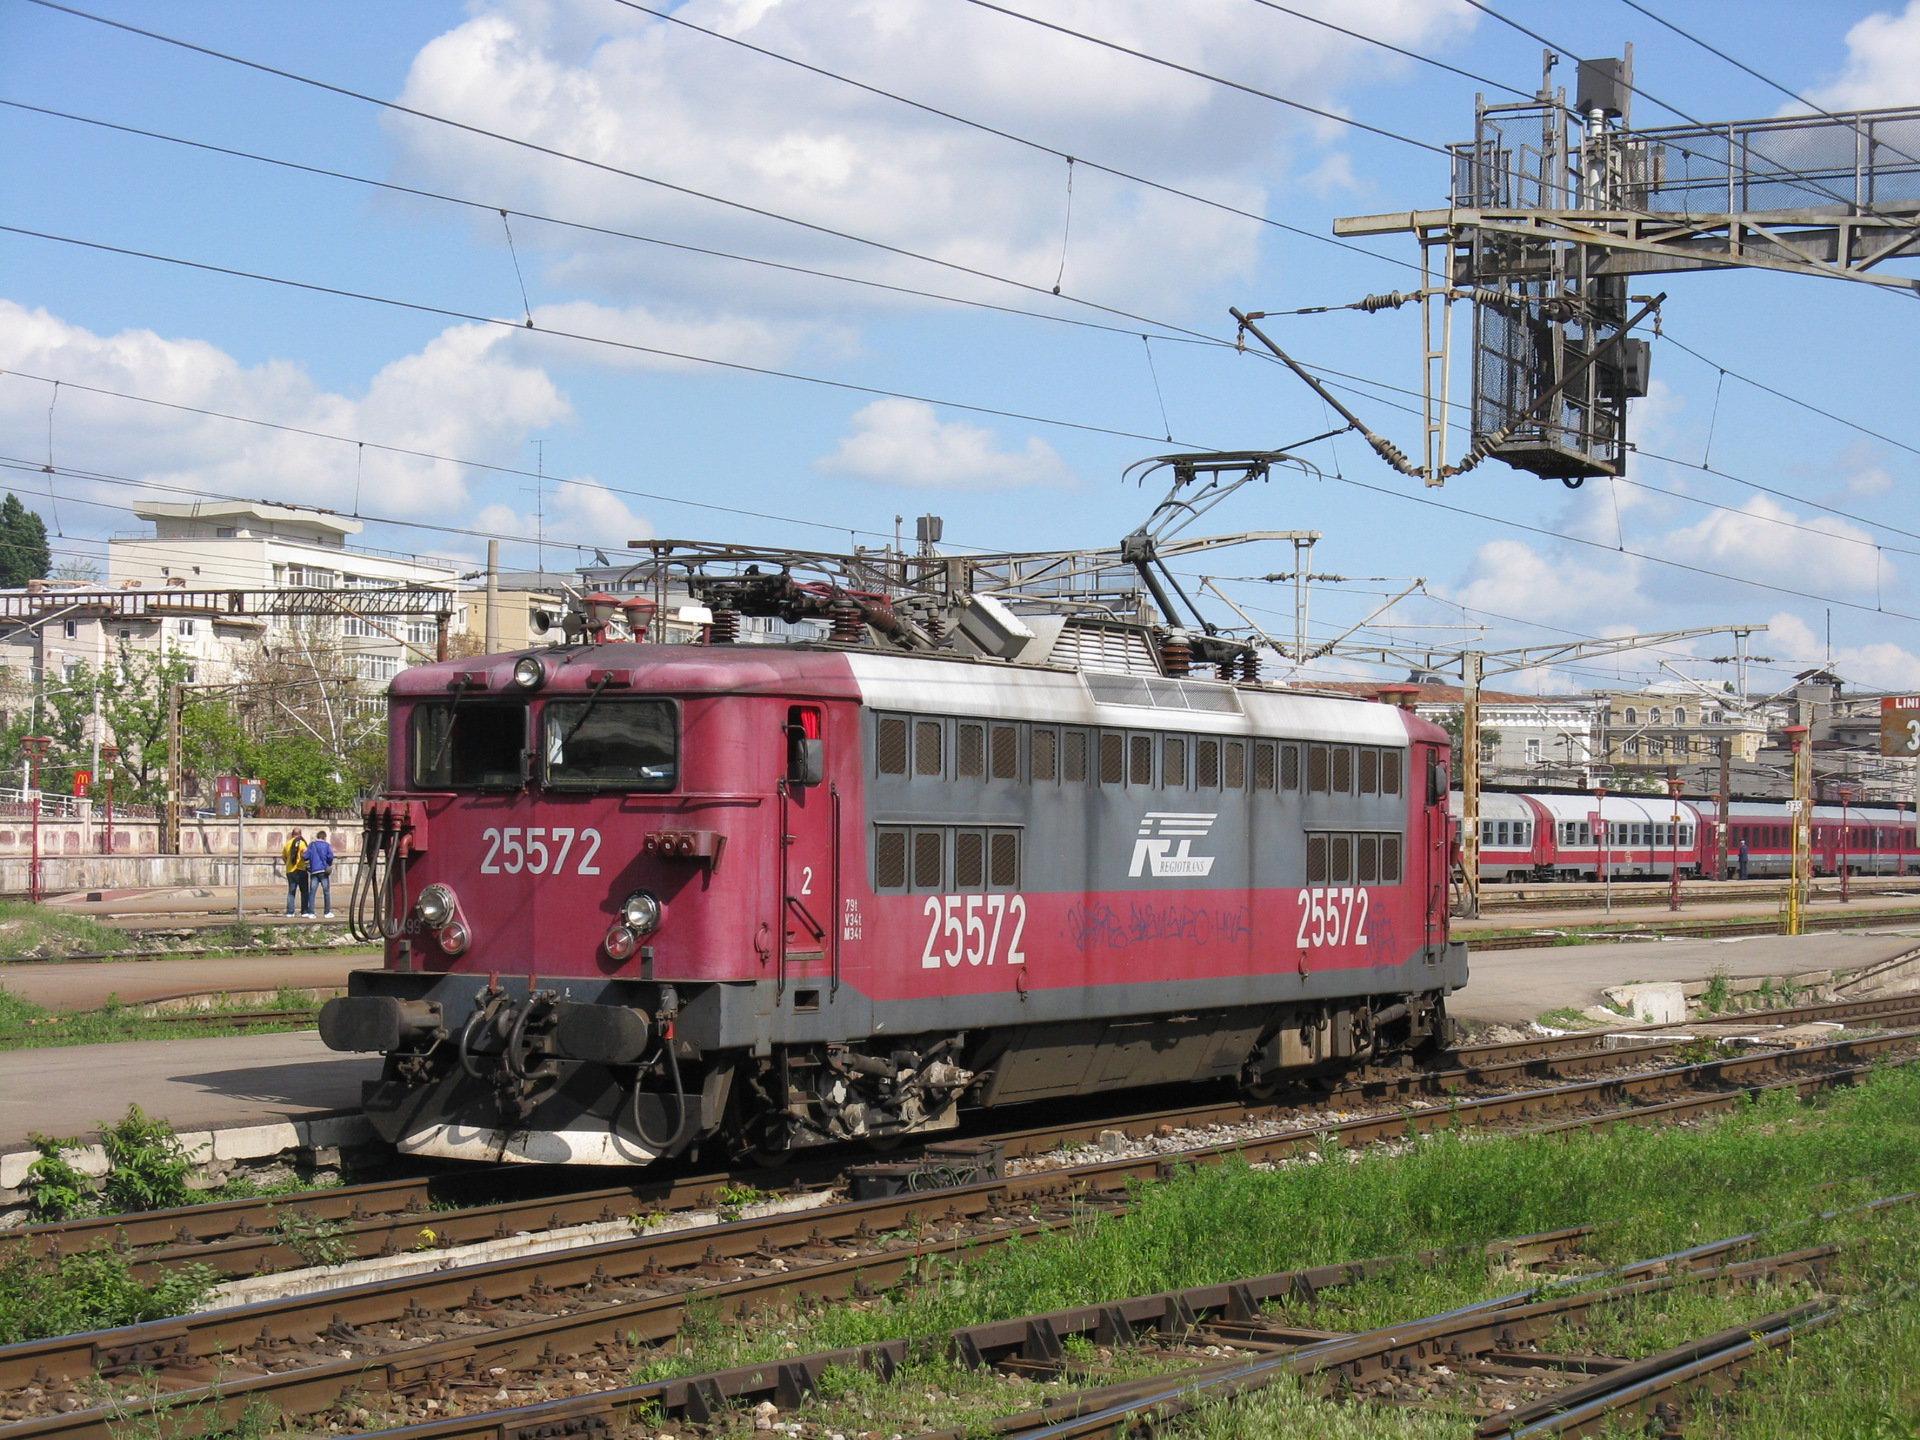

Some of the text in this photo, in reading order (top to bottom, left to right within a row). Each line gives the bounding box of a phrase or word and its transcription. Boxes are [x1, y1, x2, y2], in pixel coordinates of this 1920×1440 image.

[1906, 719, 1920, 750] 3
[250, 788, 257, 803] 8
[224, 801, 231, 816] 9
[1594, 820, 1605, 834] H
[480, 827, 602, 876] 25572
[1160, 860, 1205, 873] REGIOTRANS
[801, 866, 812, 895] 2
[845, 899, 858, 912] 79t
[1296, 887, 1369, 949] 25572
[922, 894, 1026, 969] 25572
